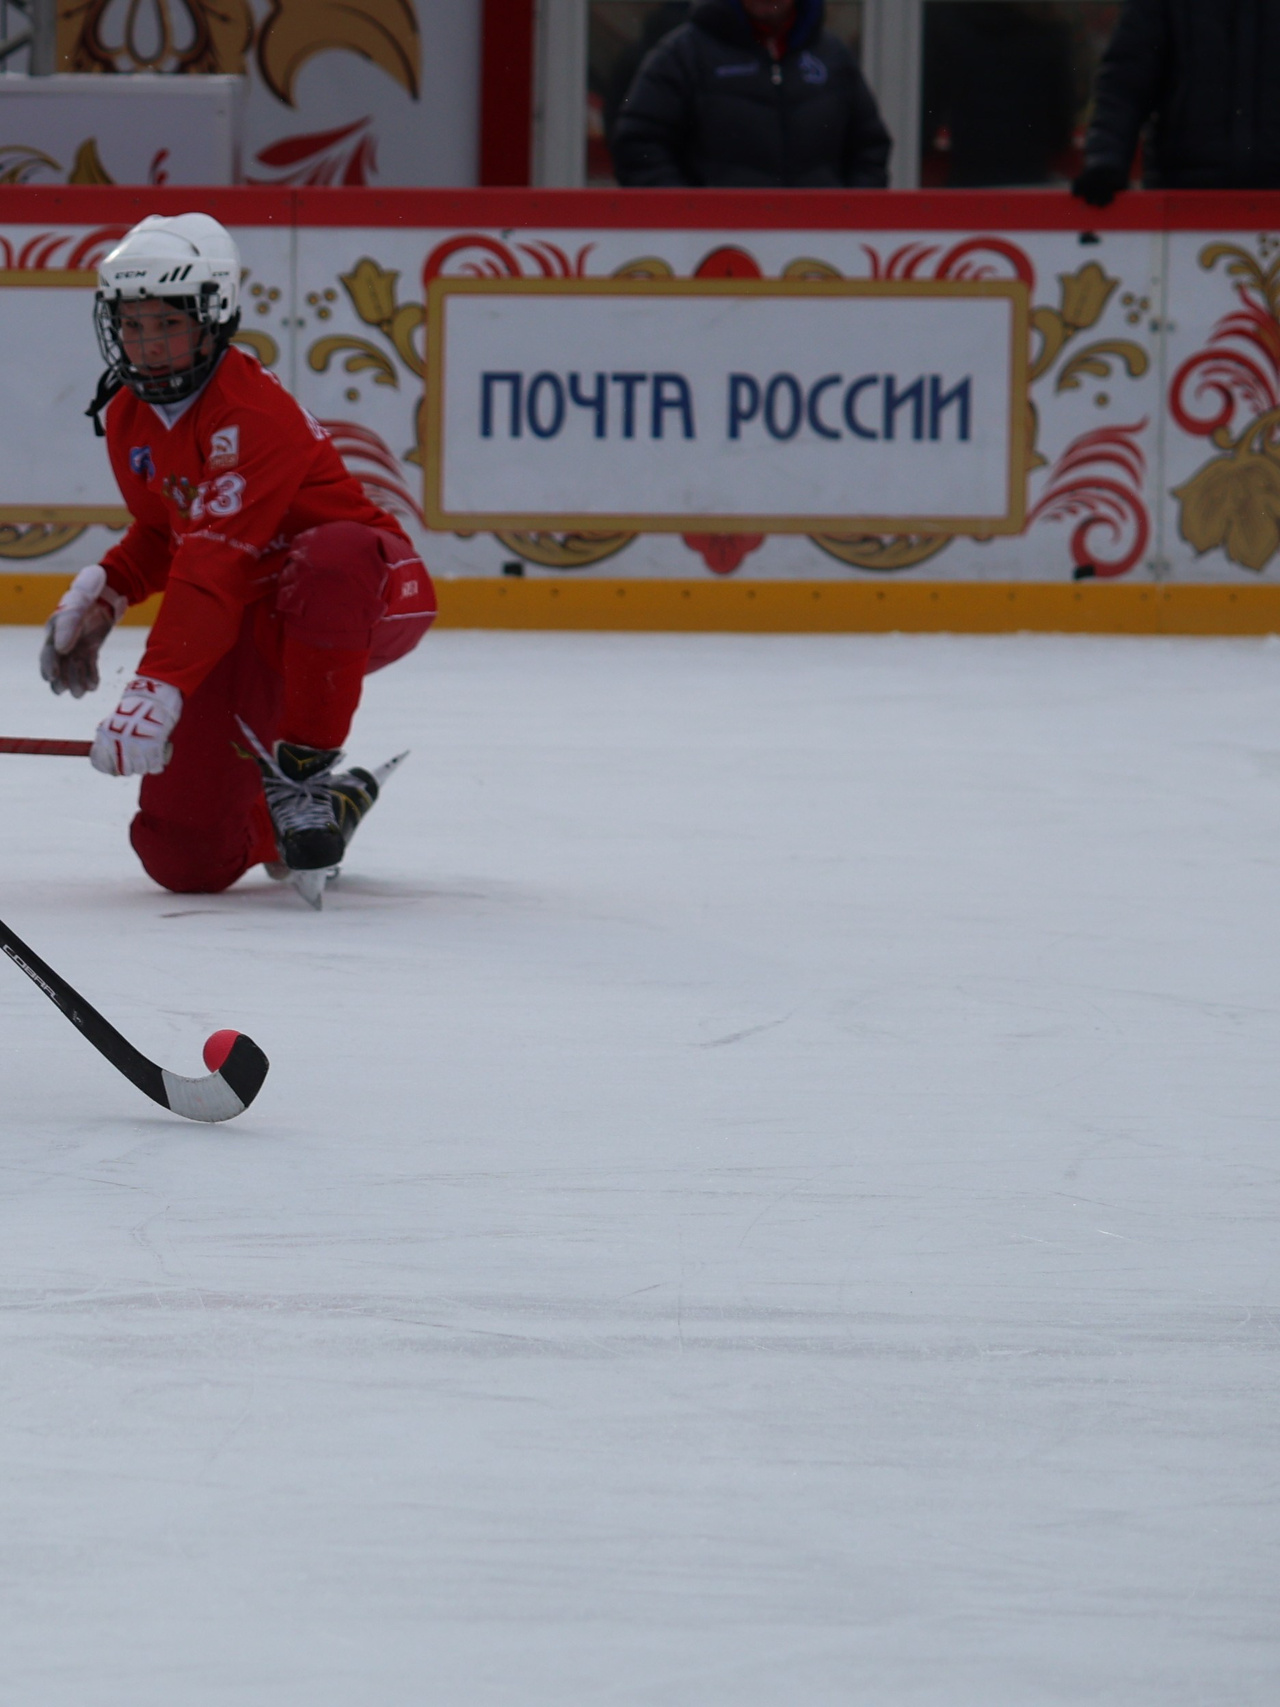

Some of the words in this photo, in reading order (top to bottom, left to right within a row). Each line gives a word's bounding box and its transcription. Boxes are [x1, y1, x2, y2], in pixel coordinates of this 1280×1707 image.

[480, 371, 695, 439] ПОЧТА
[727, 372, 971, 441] РОССИИ
[3, 944, 61, 1006] COBRA
